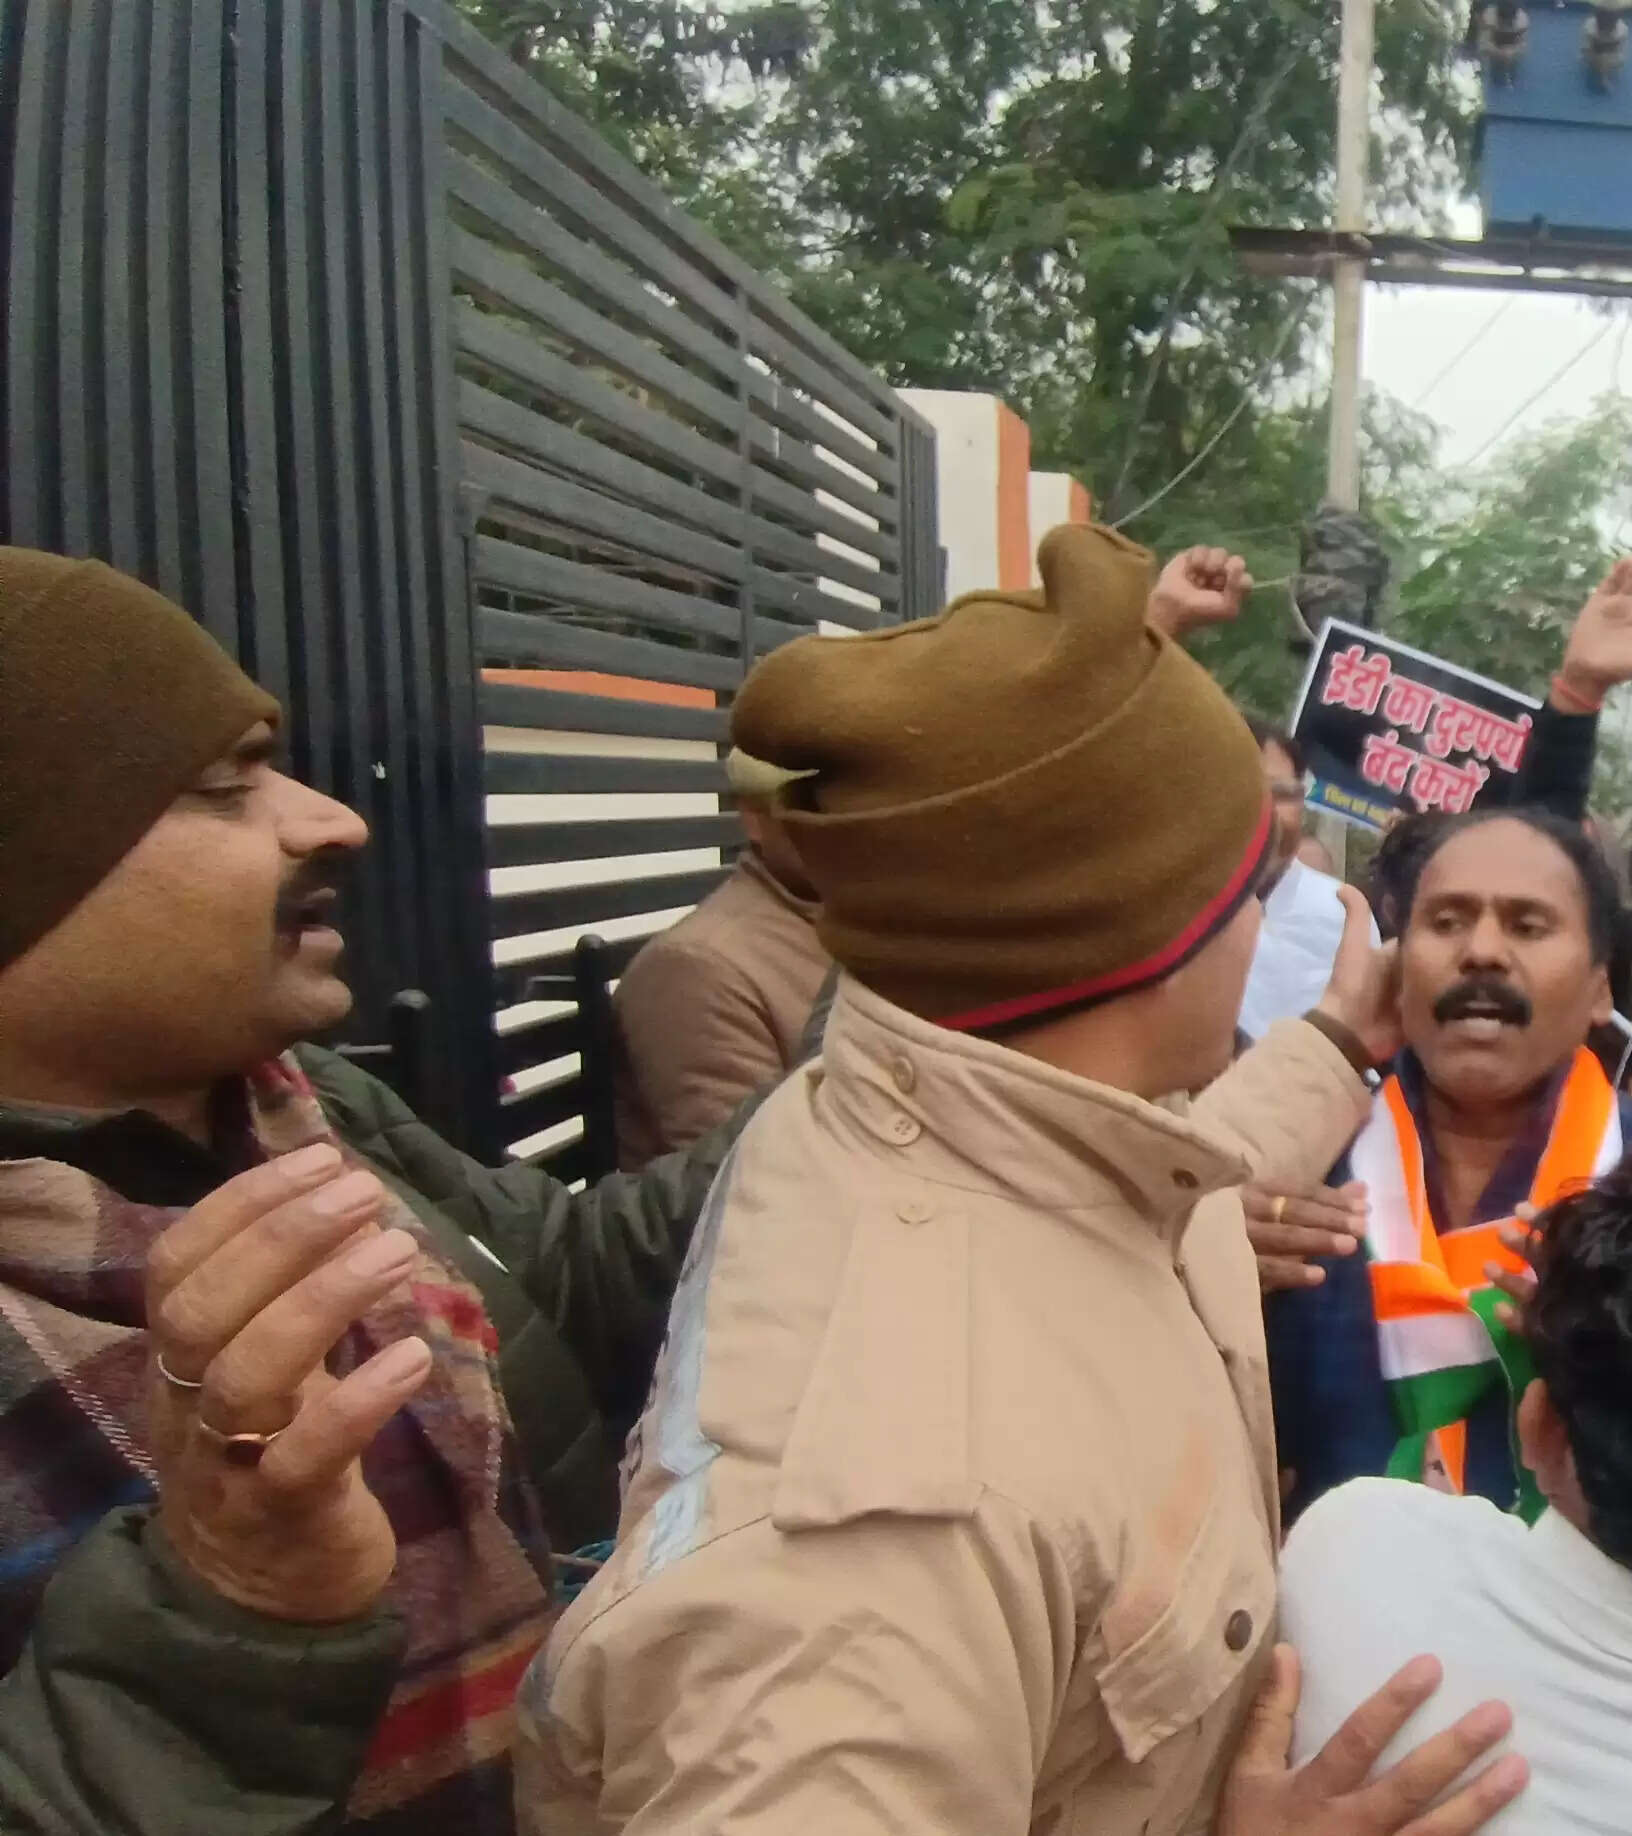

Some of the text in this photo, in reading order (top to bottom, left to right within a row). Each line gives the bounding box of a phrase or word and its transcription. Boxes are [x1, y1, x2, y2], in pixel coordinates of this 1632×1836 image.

[1321, 645, 1391, 714] ईडी
[1384, 674, 1438, 733] का
[1363, 730, 1415, 794] बंद
